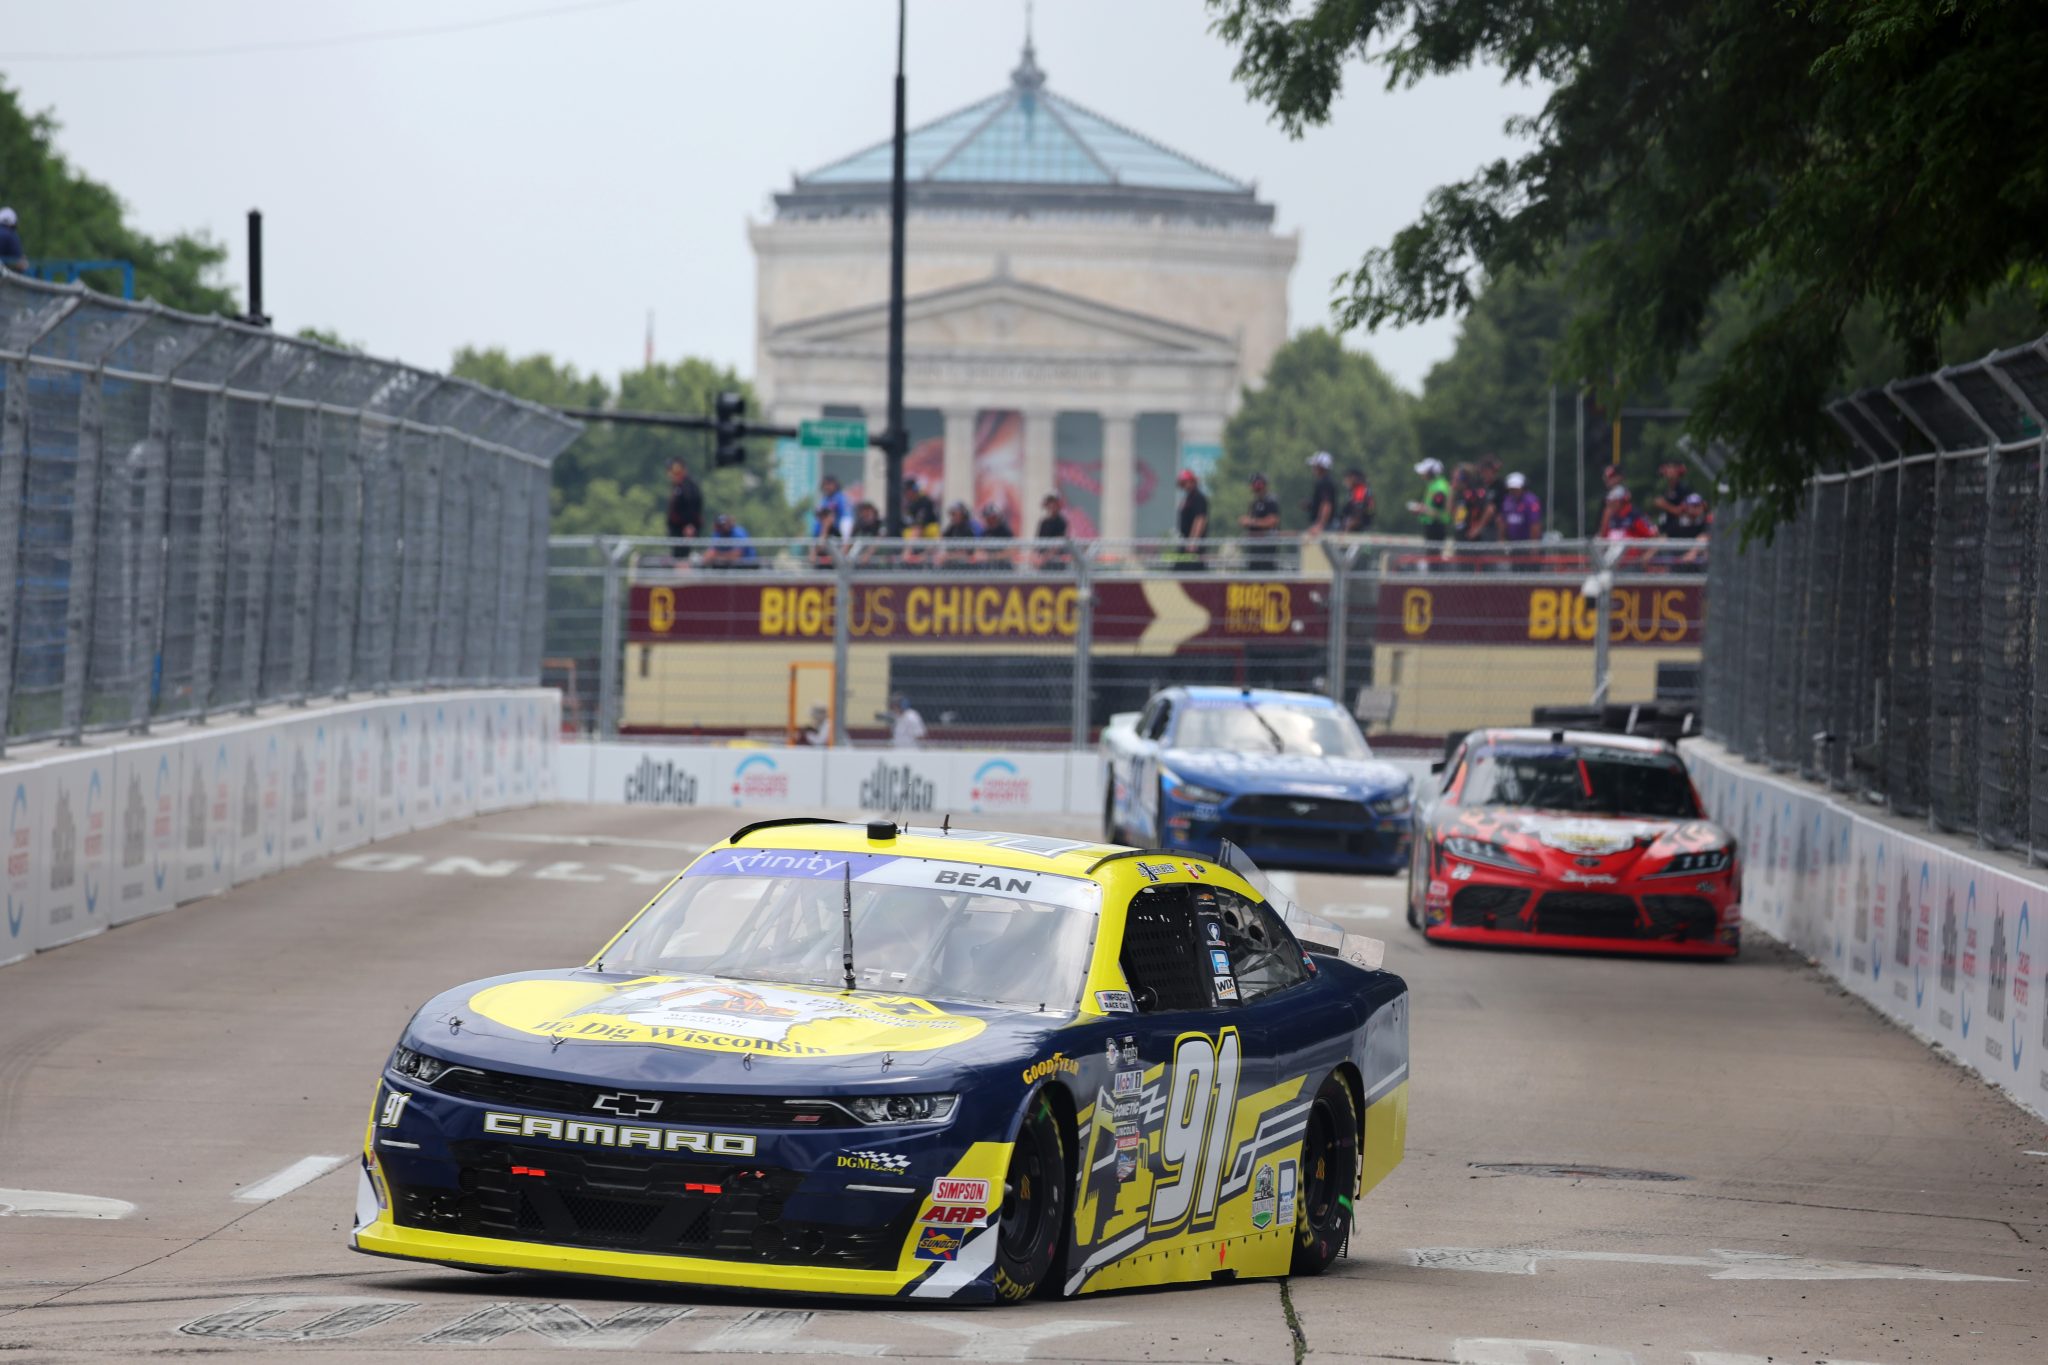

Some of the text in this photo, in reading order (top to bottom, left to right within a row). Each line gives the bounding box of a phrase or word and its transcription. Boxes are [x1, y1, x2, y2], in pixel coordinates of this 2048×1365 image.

[905, 586, 1081, 635] CHICAGO
[624, 754, 698, 805] CHICAGO
[859, 757, 935, 812] CHICAGO
[334, 853, 685, 884] ONLY
[723, 851, 848, 876] xfinity
[934, 870, 1032, 894] BEAN
[1215, 979, 1233, 991] WIX
[577, 1022, 636, 1040] Dig
[650, 1027, 827, 1054] Wisconsin
[1022, 1053, 1080, 1085] GOODYEAR
[380, 1092, 412, 1127] 91
[484, 1111, 756, 1157] CAMARO
[1149, 1027, 1241, 1229] 91
[937, 1181, 985, 1200] SIMPSON
[921, 1206, 987, 1224] ARP
[920, 1239, 961, 1249] SUNOCO
